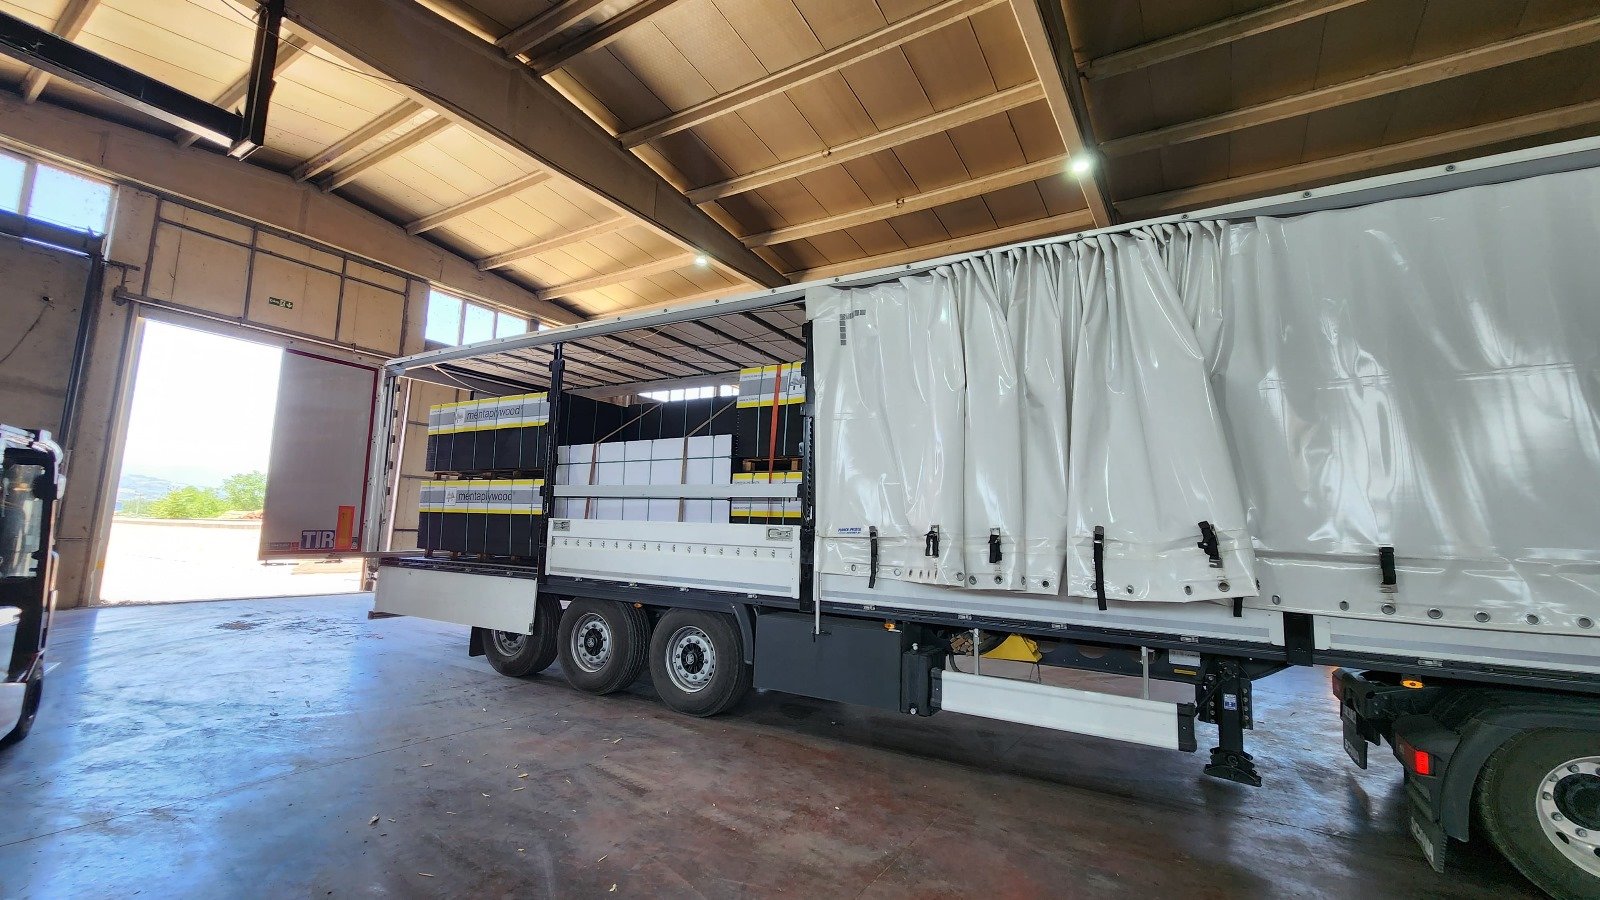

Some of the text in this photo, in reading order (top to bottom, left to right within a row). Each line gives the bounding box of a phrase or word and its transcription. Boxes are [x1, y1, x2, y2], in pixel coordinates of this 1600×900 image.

[466, 405, 521, 420] mentaplywood
[458, 491, 513, 503] mentaplywood
[302, 531, 334, 548] TIR
